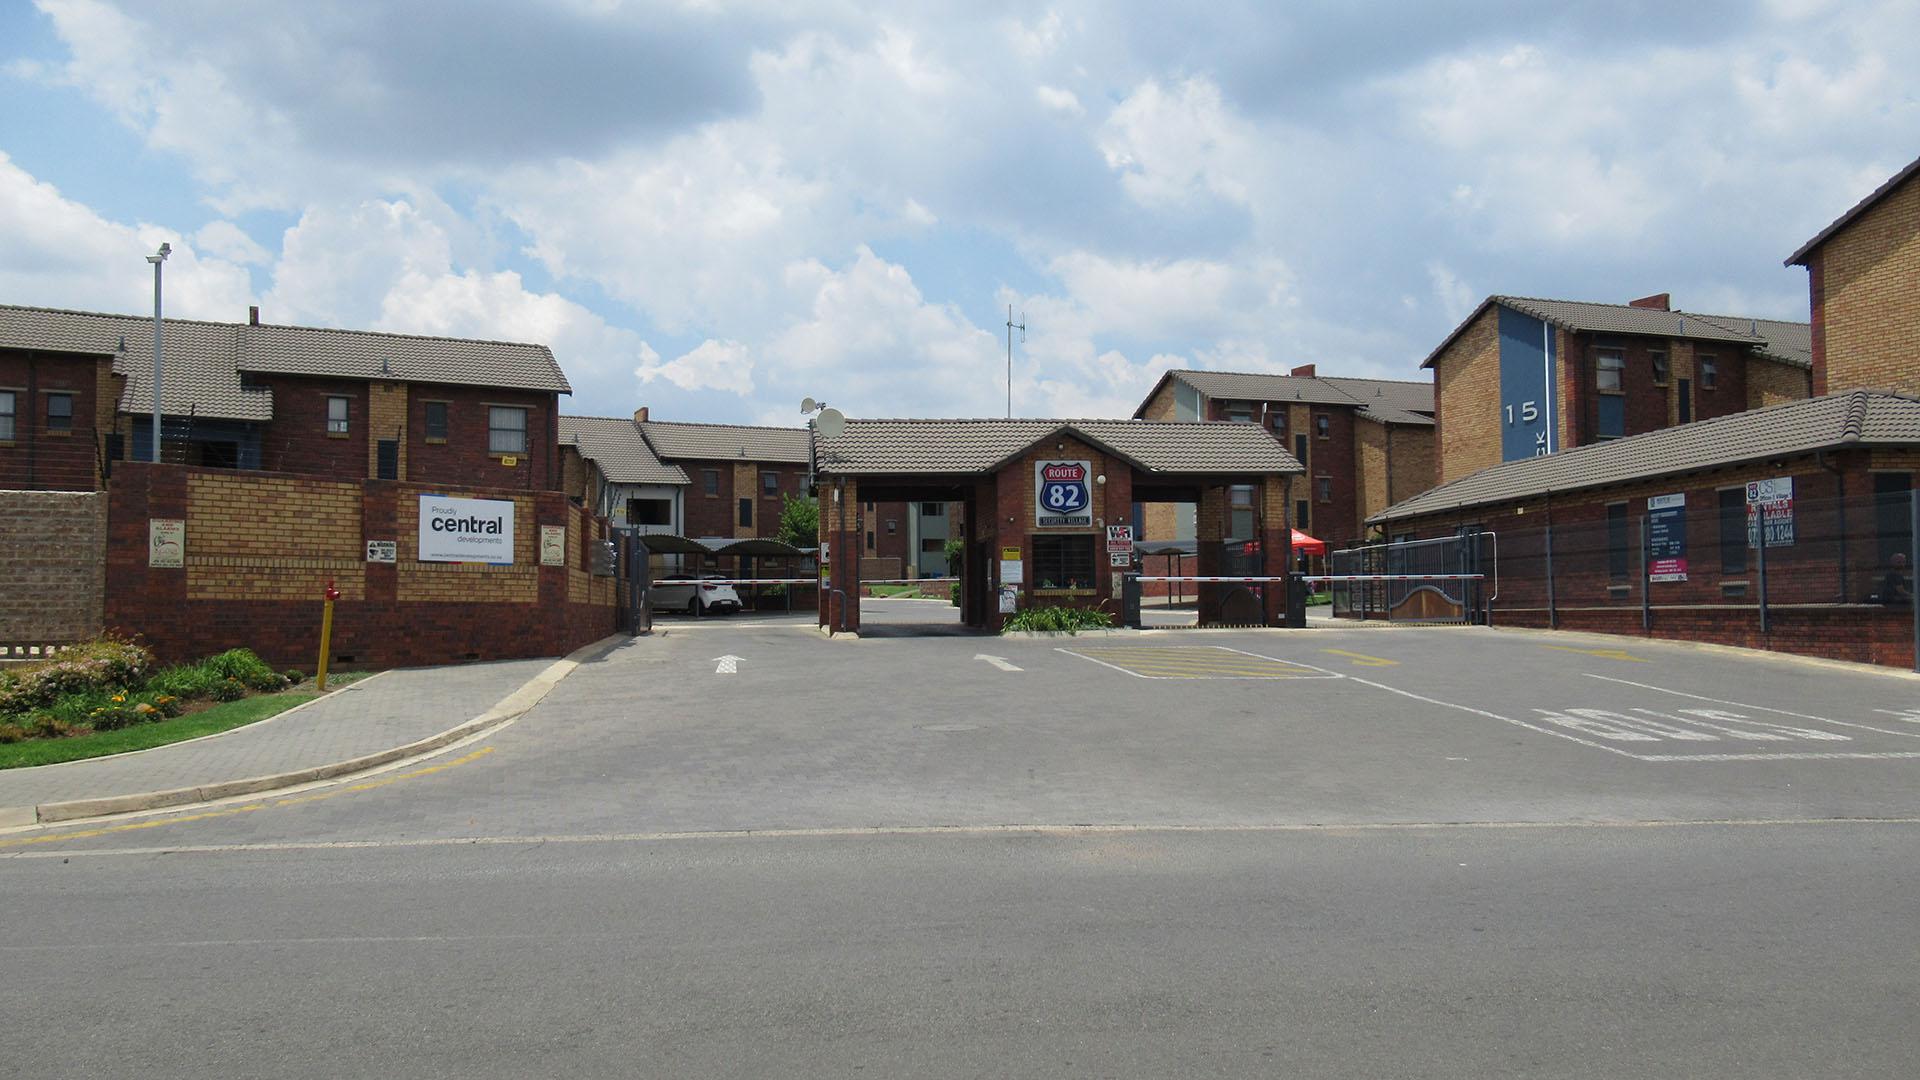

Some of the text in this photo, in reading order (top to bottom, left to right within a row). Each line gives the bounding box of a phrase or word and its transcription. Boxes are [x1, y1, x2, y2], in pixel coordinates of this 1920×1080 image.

[1505, 401, 1538, 424] 15
[1049, 469, 1078, 478] ROUTE
[1050, 485, 1079, 507] 82
[432, 506, 457, 515] Proudly
[1750, 500, 1788, 513] RNTALS
[1043, 516, 1087, 525] SECURITY VILLAGE
[1747, 509, 1792, 522] AVILABLE
[431, 516, 502, 534] central
[457, 536, 502, 544] developments
